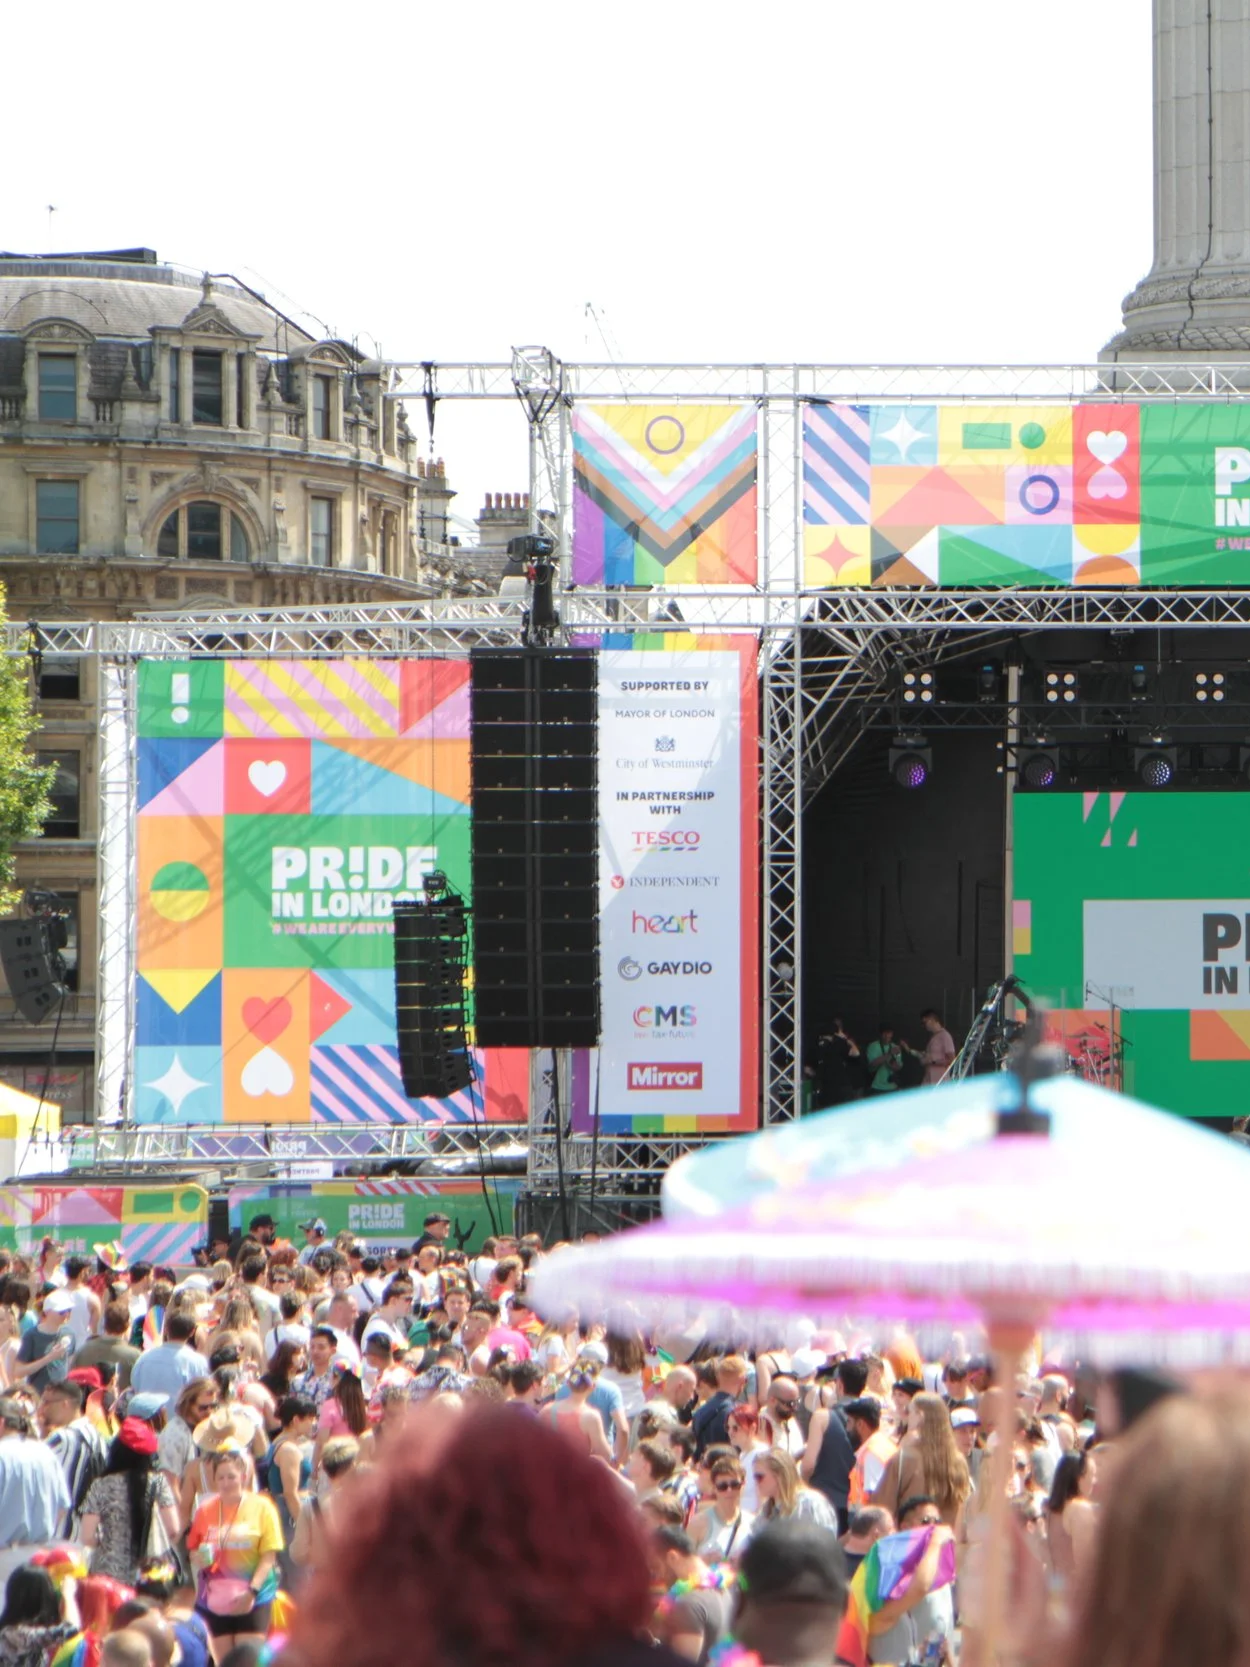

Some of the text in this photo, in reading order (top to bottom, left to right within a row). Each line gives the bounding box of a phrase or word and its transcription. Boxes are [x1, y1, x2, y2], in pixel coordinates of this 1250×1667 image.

[1215, 498, 1250, 527] IN
[620, 681, 709, 691] SUPPORTED BY
[615, 709, 715, 718] MAYOR OF LONDON
[616, 757, 714, 770] City of Westminster
[616, 791, 715, 801] IN PARTNERSHIP
[649, 805, 681, 815] WITH
[631, 831, 700, 845] TESCO
[272, 846, 437, 890] PR!DE
[629, 876, 720, 887] INDEPENDENT
[272, 892, 303, 917] IN
[631, 909, 698, 934] heart
[647, 961, 712, 975] GAYDIO
[1203, 966, 1238, 994] IN
[633, 1005, 697, 1027] CMS
[631, 1066, 698, 1087] Mirror
[348, 1203, 404, 1220] PR!DE
[348, 1219, 404, 1229] IN LONDON
